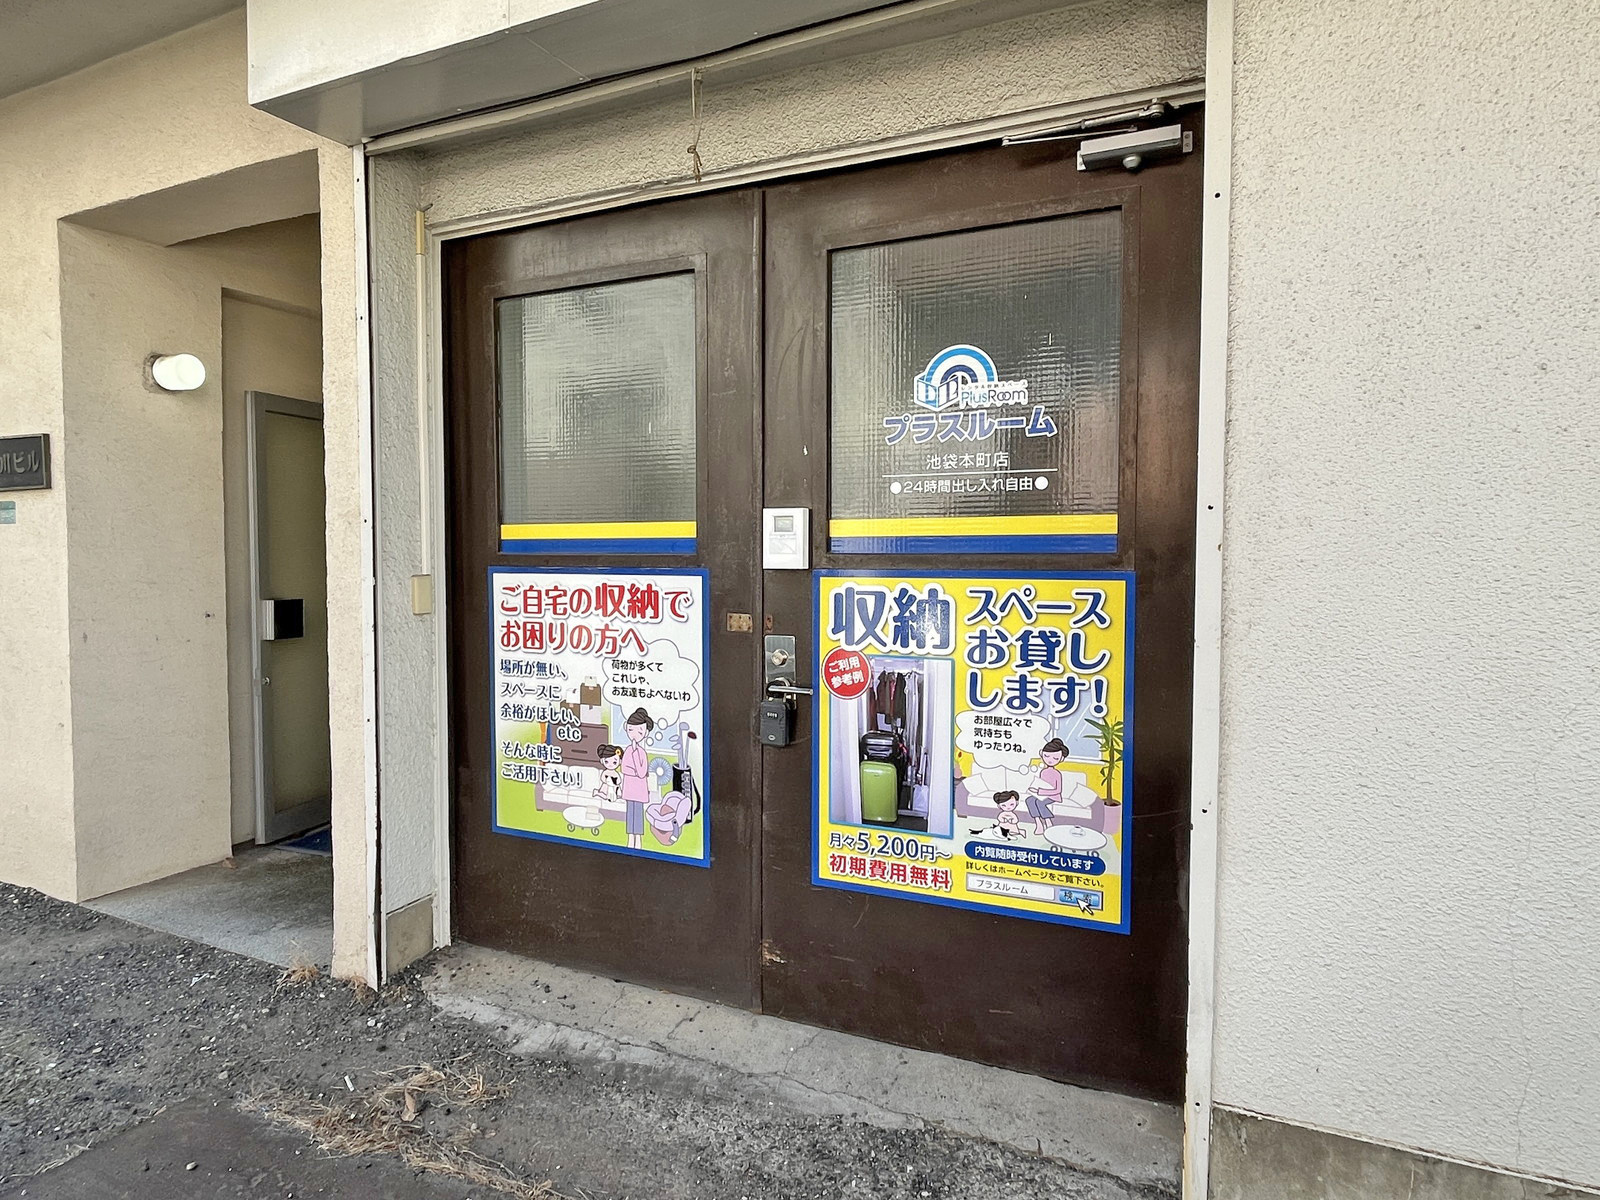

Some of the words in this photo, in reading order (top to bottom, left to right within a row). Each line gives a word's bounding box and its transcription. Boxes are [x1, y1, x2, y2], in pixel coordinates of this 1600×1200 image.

[884, 406, 1057, 444] プラスルーム
[926, 452, 1009, 470] 池袋本町店
[501, 583, 690, 619] ご自宅の収納で
[967, 587, 1108, 628] スペース
[831, 586, 951, 650] 収納
[501, 620, 645, 655] お困りの方へ
[966, 628, 1107, 671] お貸し
[500, 659, 567, 678] 場所が無い、
[611, 659, 663, 673] 荷物が多くて
[828, 656, 861, 672] ご利用
[612, 673, 650, 686] これじゃ、
[830, 670, 865, 689] 参考例
[501, 682, 561, 699] スペースに
[612, 686, 691, 702] お友達もよべないわ
[500, 703, 580, 725] 余裕がほしい、
[973, 715, 1033, 728] お部屋広々で
[558, 728, 580, 740] etc
[973, 727, 1013, 739] 気持ちも
[502, 741, 561, 762] そんな時に
[973, 740, 1027, 754] ゆったりね。
[974, 845, 1095, 871] 内覧随時受付しています
[829, 853, 950, 889] 初期費用無料
[965, 861, 1105, 888] 詳しくはホームページをご覧下さい。
[976, 879, 1029, 895] プラスルーム
